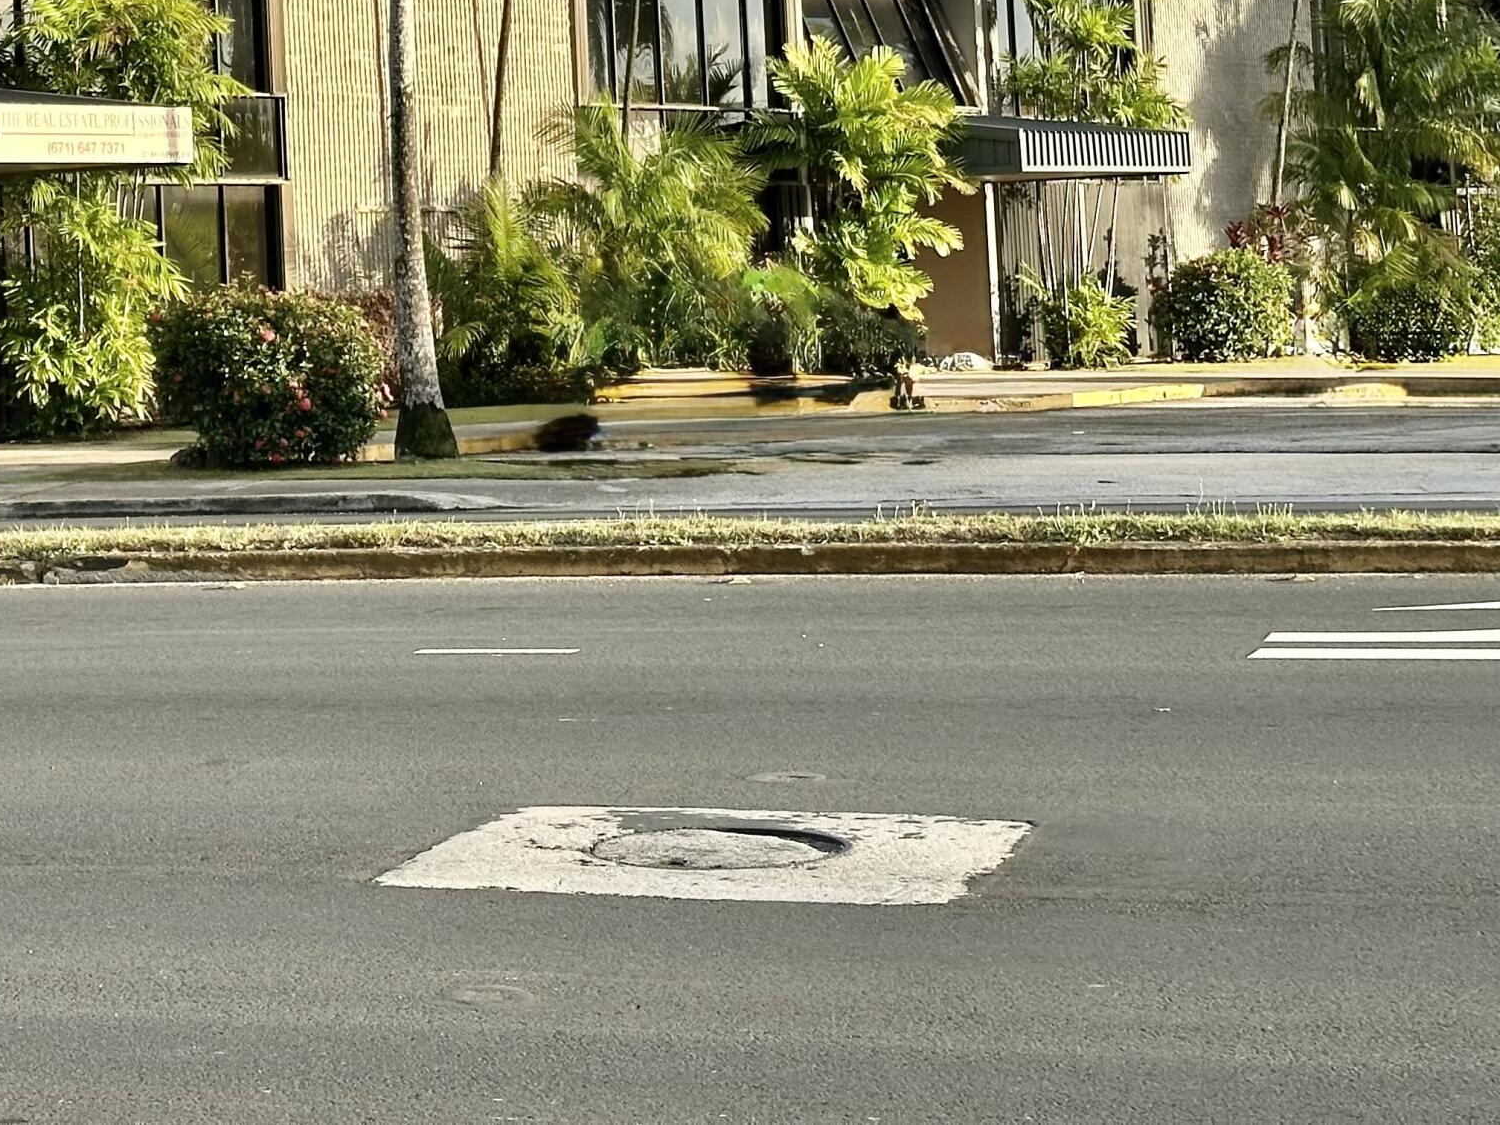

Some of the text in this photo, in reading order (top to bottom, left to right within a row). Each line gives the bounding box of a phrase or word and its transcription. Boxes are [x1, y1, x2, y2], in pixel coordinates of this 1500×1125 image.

[26, 112, 56, 128] REAL
[59, 113, 101, 129] ESTATE
[48, 141, 125, 155] (671) 647 7371
